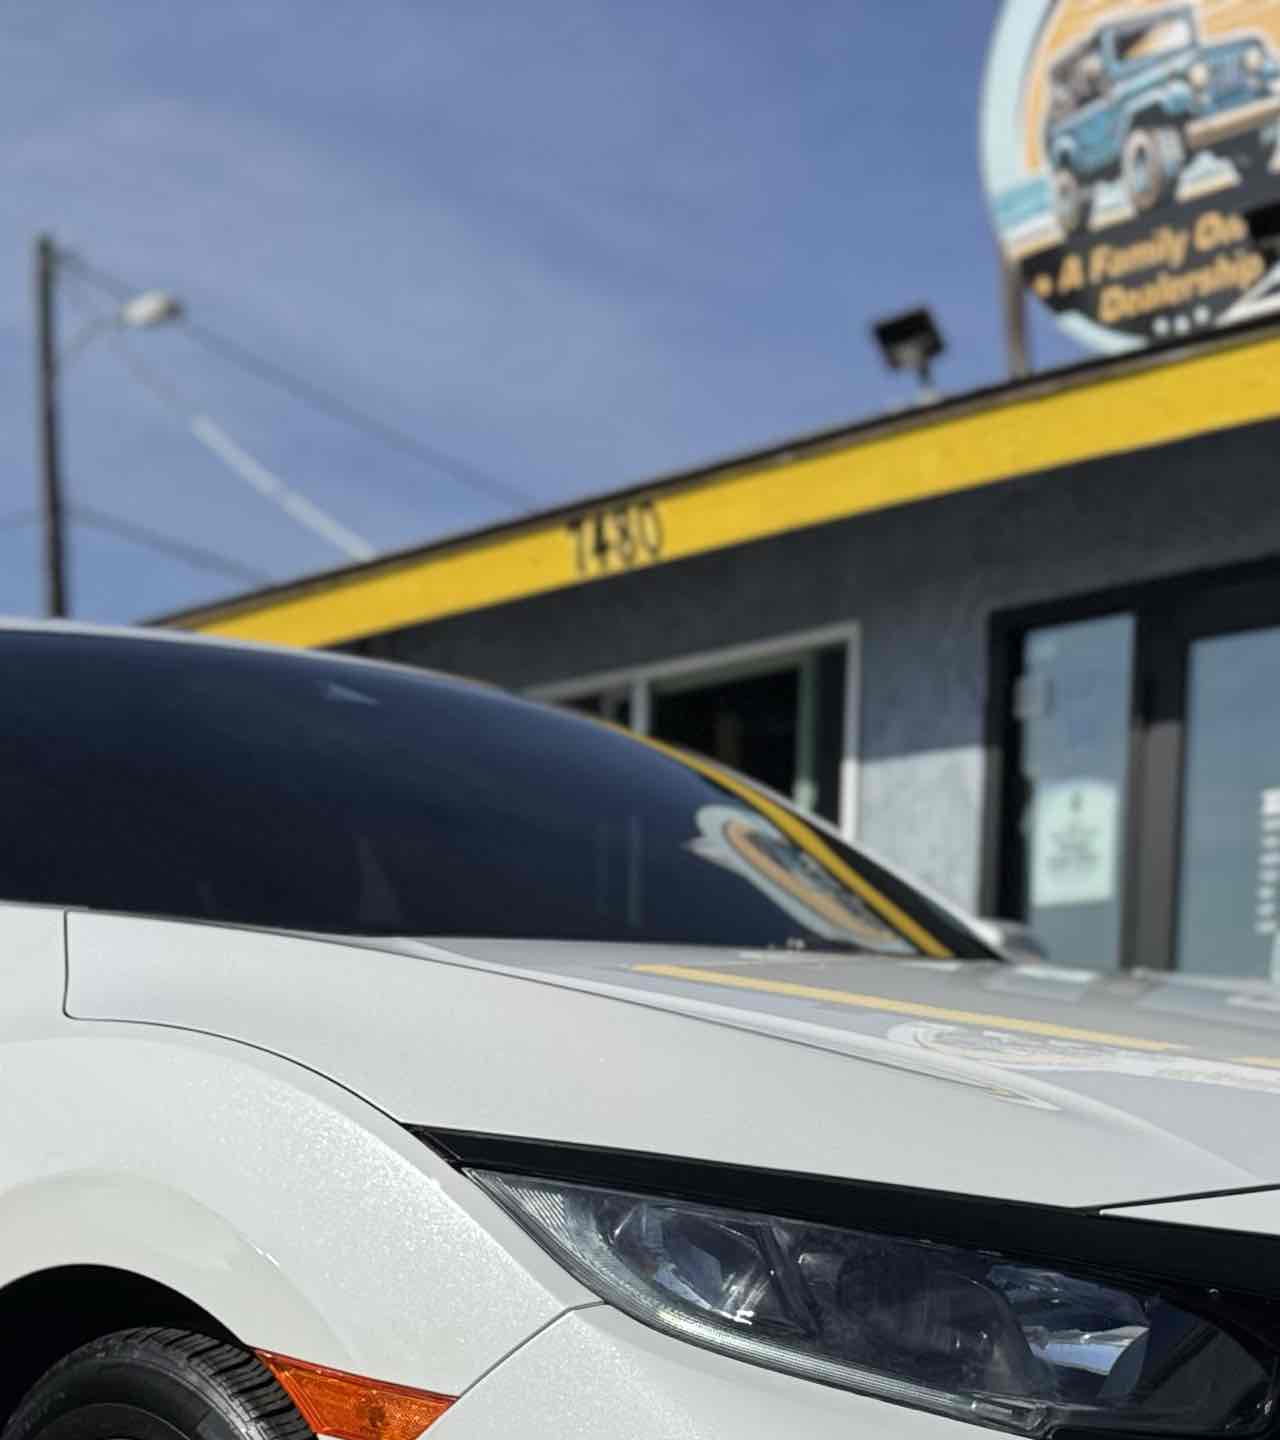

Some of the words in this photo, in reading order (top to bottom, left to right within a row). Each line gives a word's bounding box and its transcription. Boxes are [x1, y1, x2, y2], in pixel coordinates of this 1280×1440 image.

[1057, 253, 1084, 293] A
[1089, 226, 1188, 286] Family
[1097, 248, 1266, 323] Dealership
